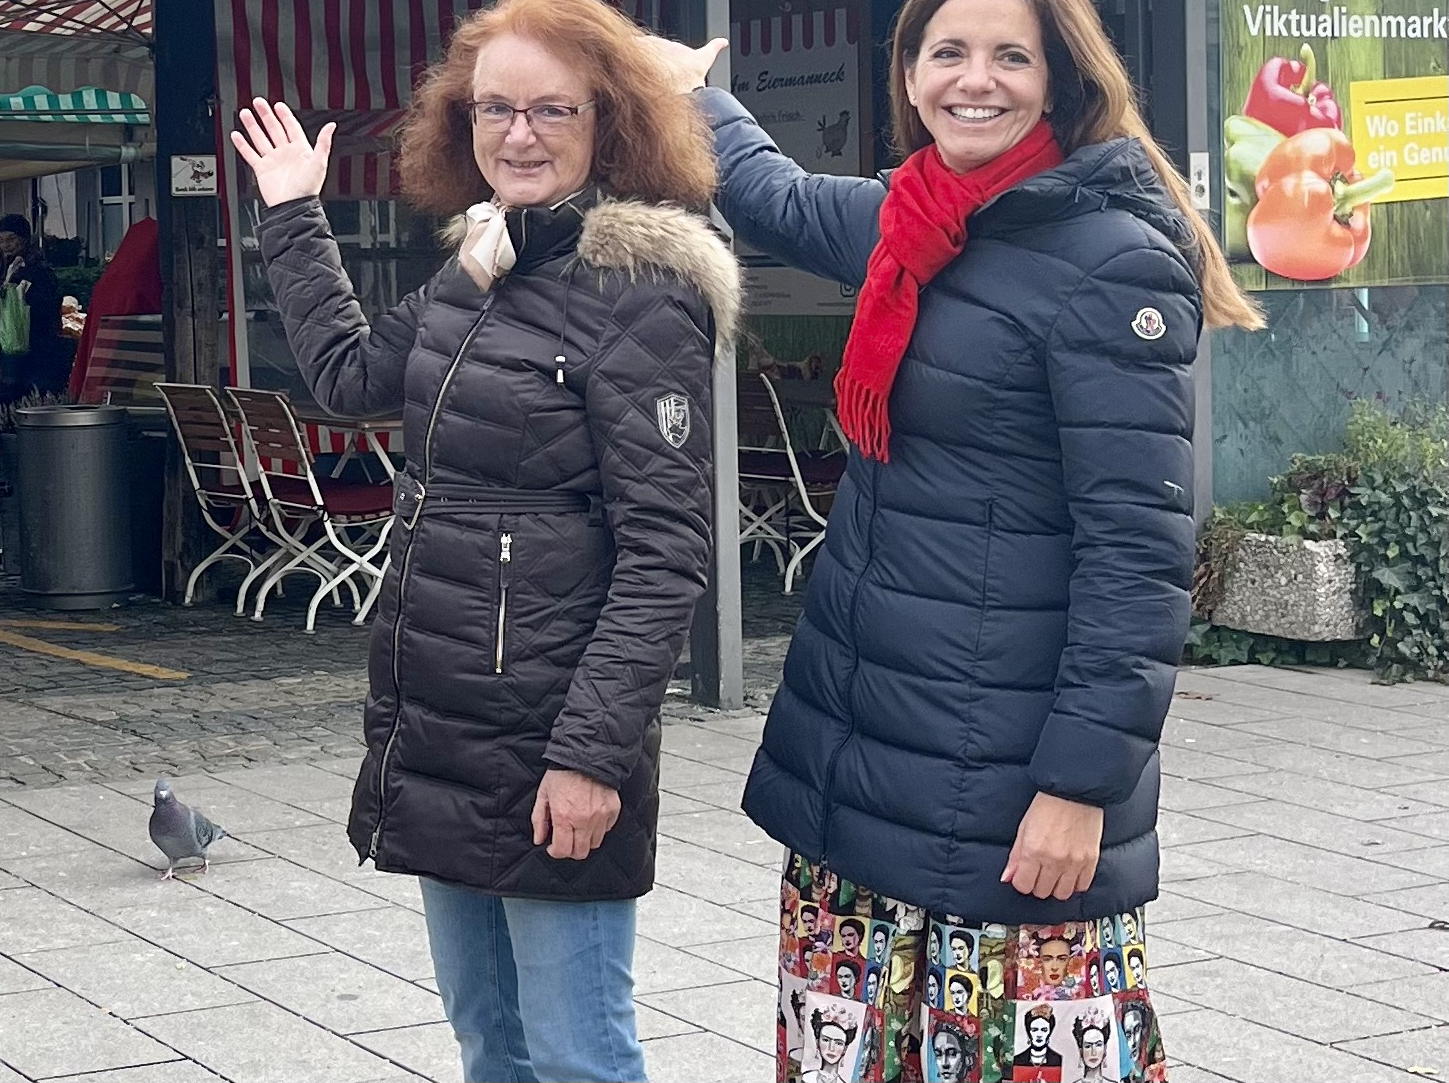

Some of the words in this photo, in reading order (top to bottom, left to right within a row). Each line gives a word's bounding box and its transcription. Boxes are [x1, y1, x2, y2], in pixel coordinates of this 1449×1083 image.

[1243, 4, 1449, 39] Viktualienmark
[756, 63, 846, 92] Eiermanneck
[1365, 114, 1399, 138] Wo
[1405, 110, 1449, 136] Eink
[1368, 144, 1398, 169] ein
